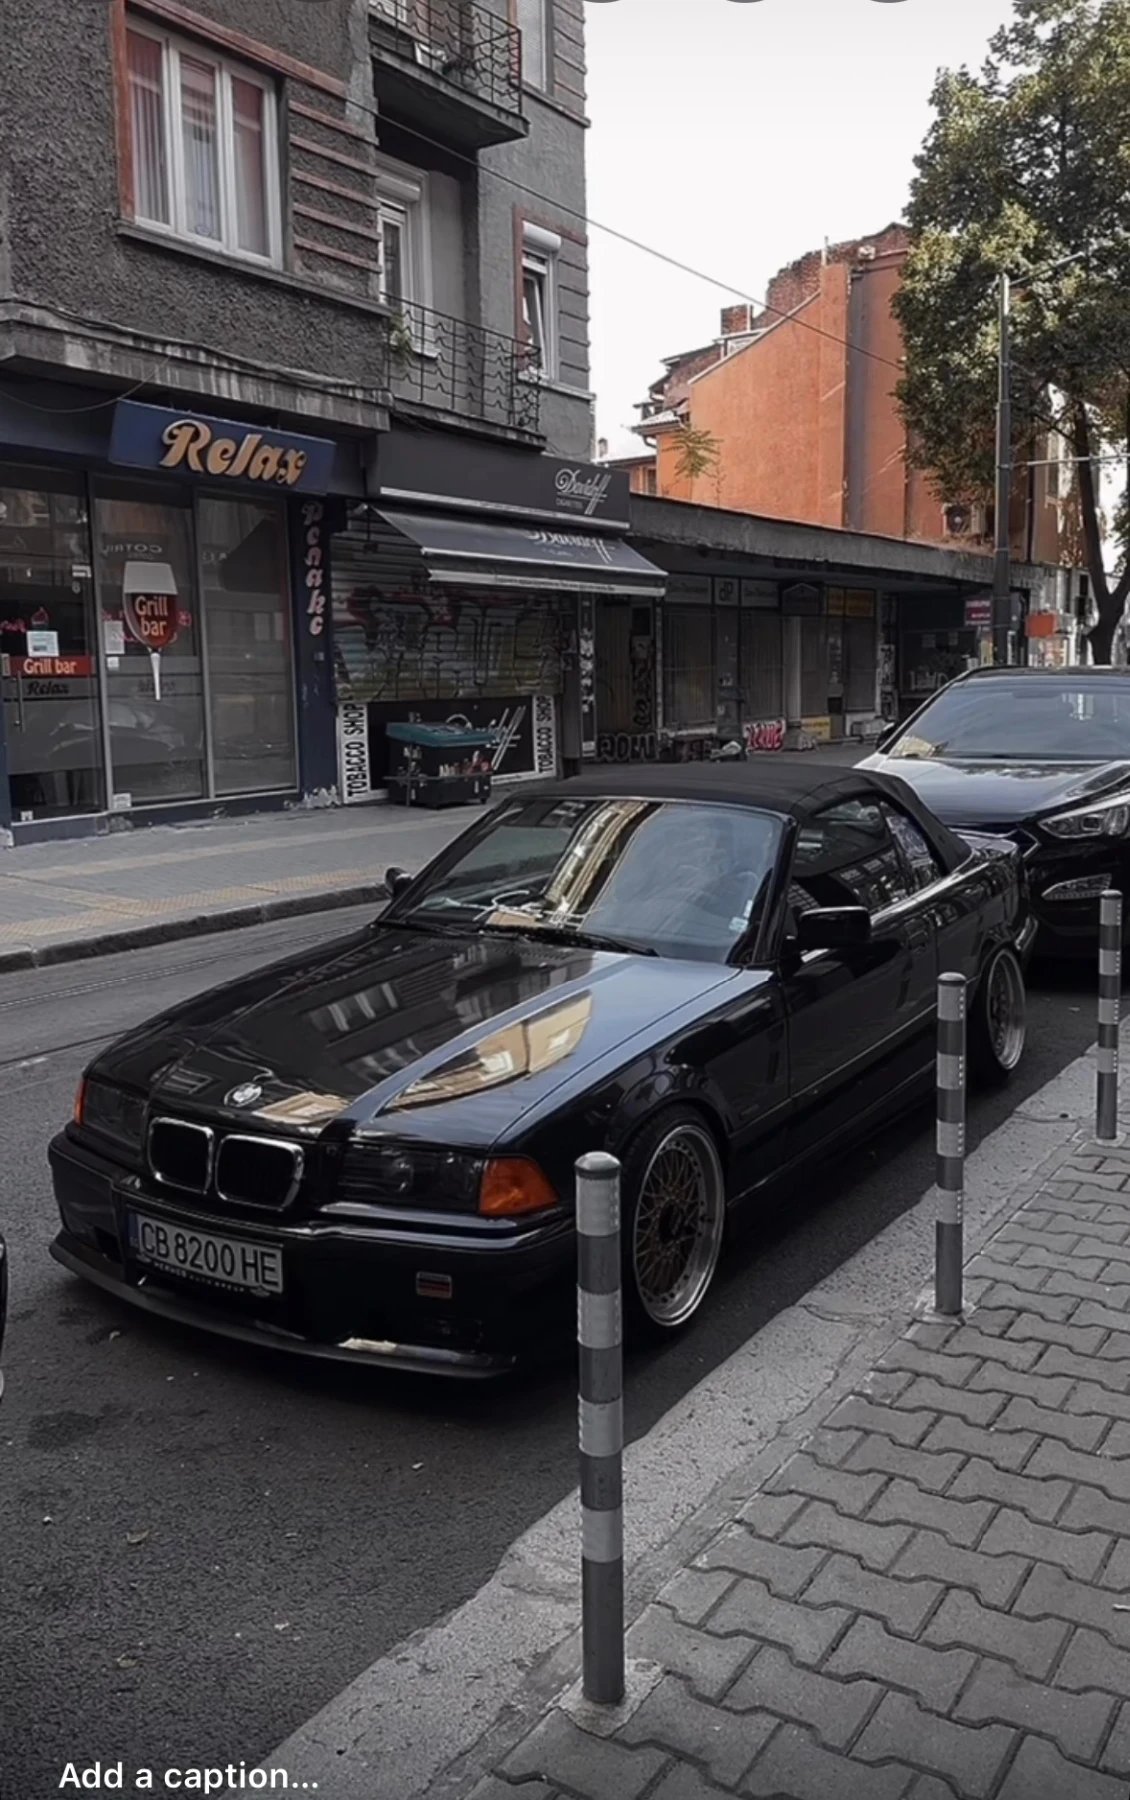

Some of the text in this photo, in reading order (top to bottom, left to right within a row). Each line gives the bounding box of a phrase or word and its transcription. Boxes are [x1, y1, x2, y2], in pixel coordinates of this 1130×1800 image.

[159, 418, 307, 485] Relax
[555, 468, 612, 515] Davidoff
[135, 595, 169, 616] Grill
[140, 617, 167, 637] bar
[23, 657, 77, 675] Grill bar
[27, 681, 70, 696] Relax
[343, 702, 369, 797] TOBACCO SHOP
[536, 726, 554, 773] TOBACCO
[141, 1222, 170, 1258] CB
[174, 1233, 235, 1277] 8200
[240, 1246, 279, 1287] HE
